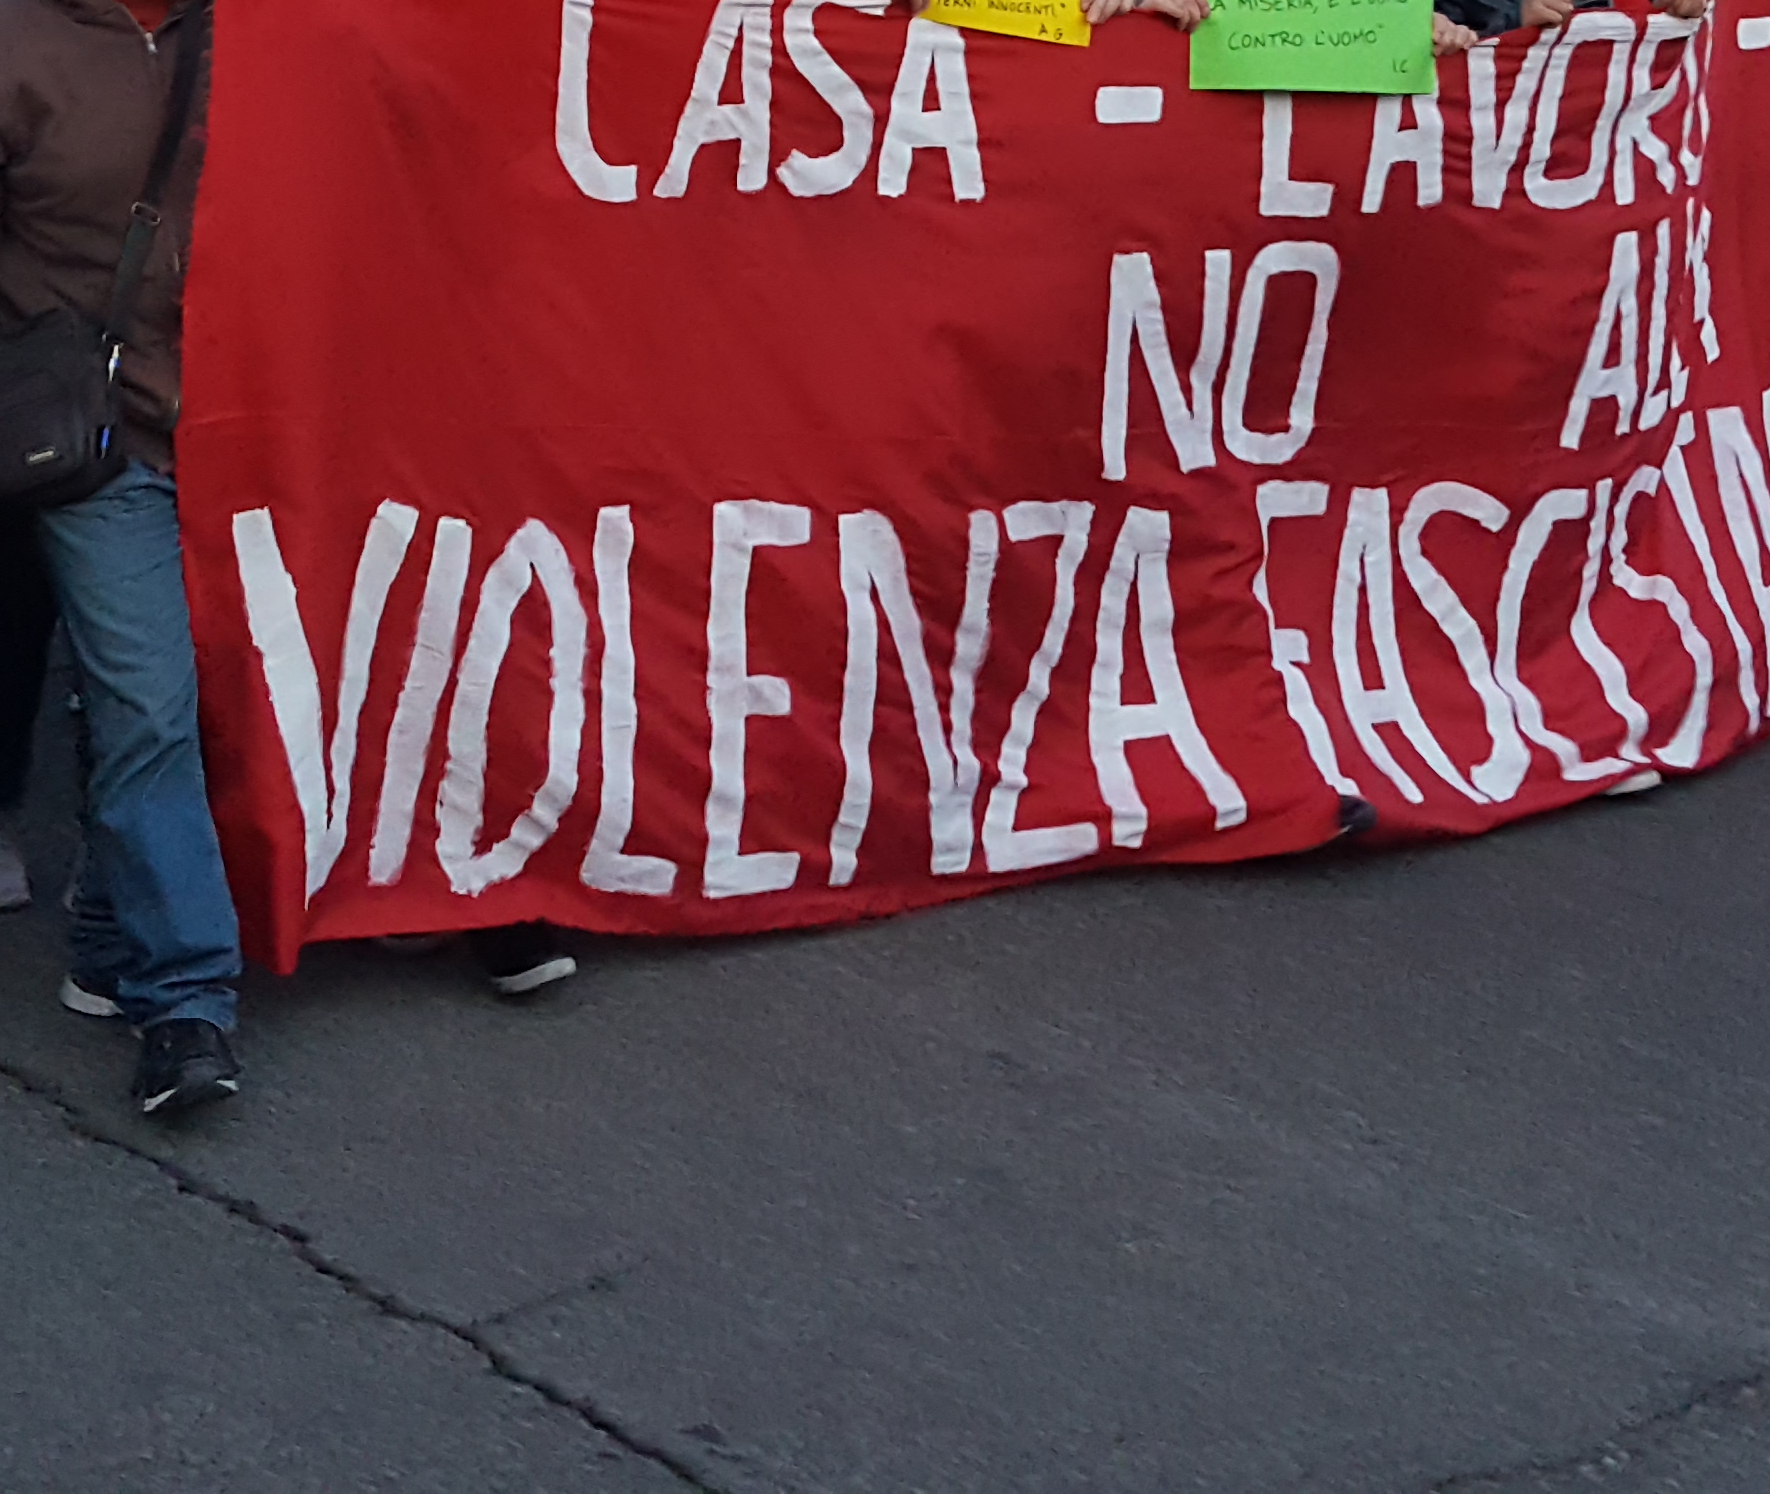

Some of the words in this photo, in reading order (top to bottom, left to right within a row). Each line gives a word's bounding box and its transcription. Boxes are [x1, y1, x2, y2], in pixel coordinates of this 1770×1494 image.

[1228, 30, 1303, 51] CONTRO
[1101, 240, 1342, 482] NO
[232, 498, 1248, 911] VIOLENZA
